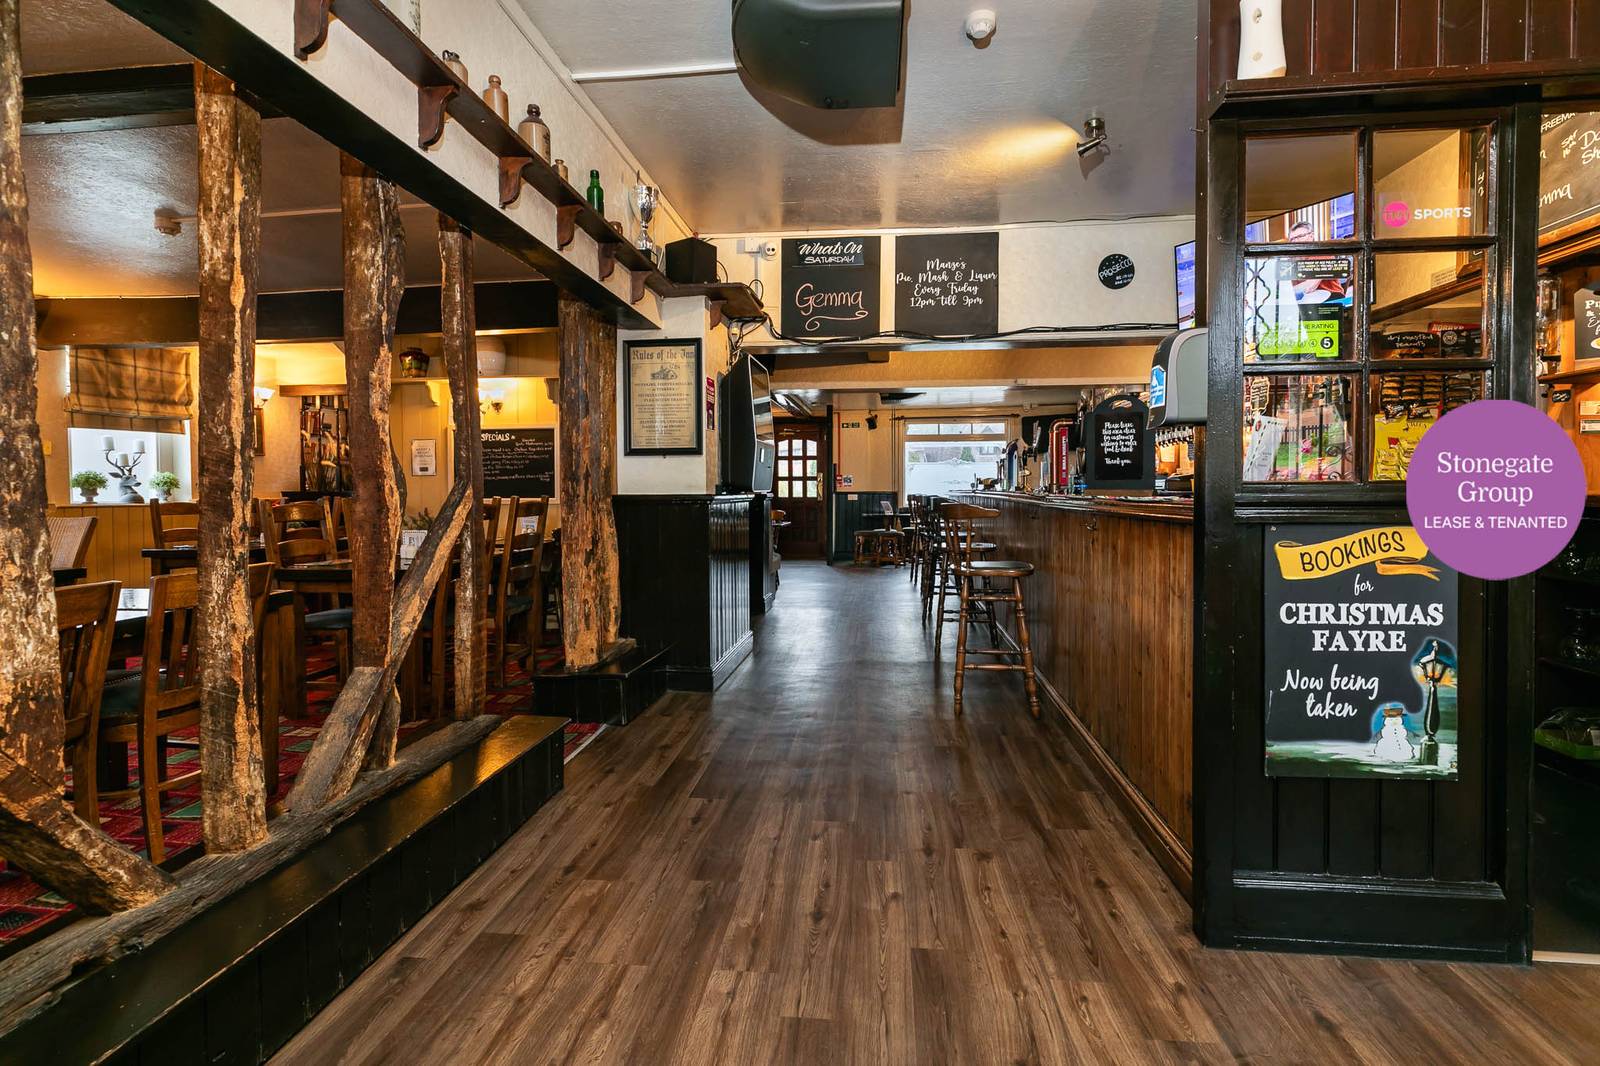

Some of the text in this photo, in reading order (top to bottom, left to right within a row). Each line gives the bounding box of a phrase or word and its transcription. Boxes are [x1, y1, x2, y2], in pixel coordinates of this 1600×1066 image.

[1413, 207, 1472, 220] SPORTS
[844, 241, 864, 255] On
[804, 256, 855, 264] SATURDAY
[926, 257, 967, 271] Manze's
[918, 270, 949, 284] Mash
[955, 270, 964, 282] &
[969, 269, 998, 283] Liquor
[1098, 257, 1134, 281] PROSECCO
[914, 281, 979, 297] Every Friday
[795, 282, 864, 316] Gemma
[910, 294, 983, 309] 12pm till 9pm
[1323, 338, 1331, 349] 5
[632, 349, 654, 360] Rules
[656, 350, 664, 361] of
[666, 349, 678, 360] the
[481, 431, 510, 442] SPECIALS
[1300, 530, 1405, 573] BOOKINGS
[1354, 574, 1374, 596] for
[1279, 603, 1444, 626] CHRISTMAS
[1312, 631, 1406, 653] FAYRE
[1280, 664, 1380, 700] Now being
[1306, 693, 1357, 718] taken
